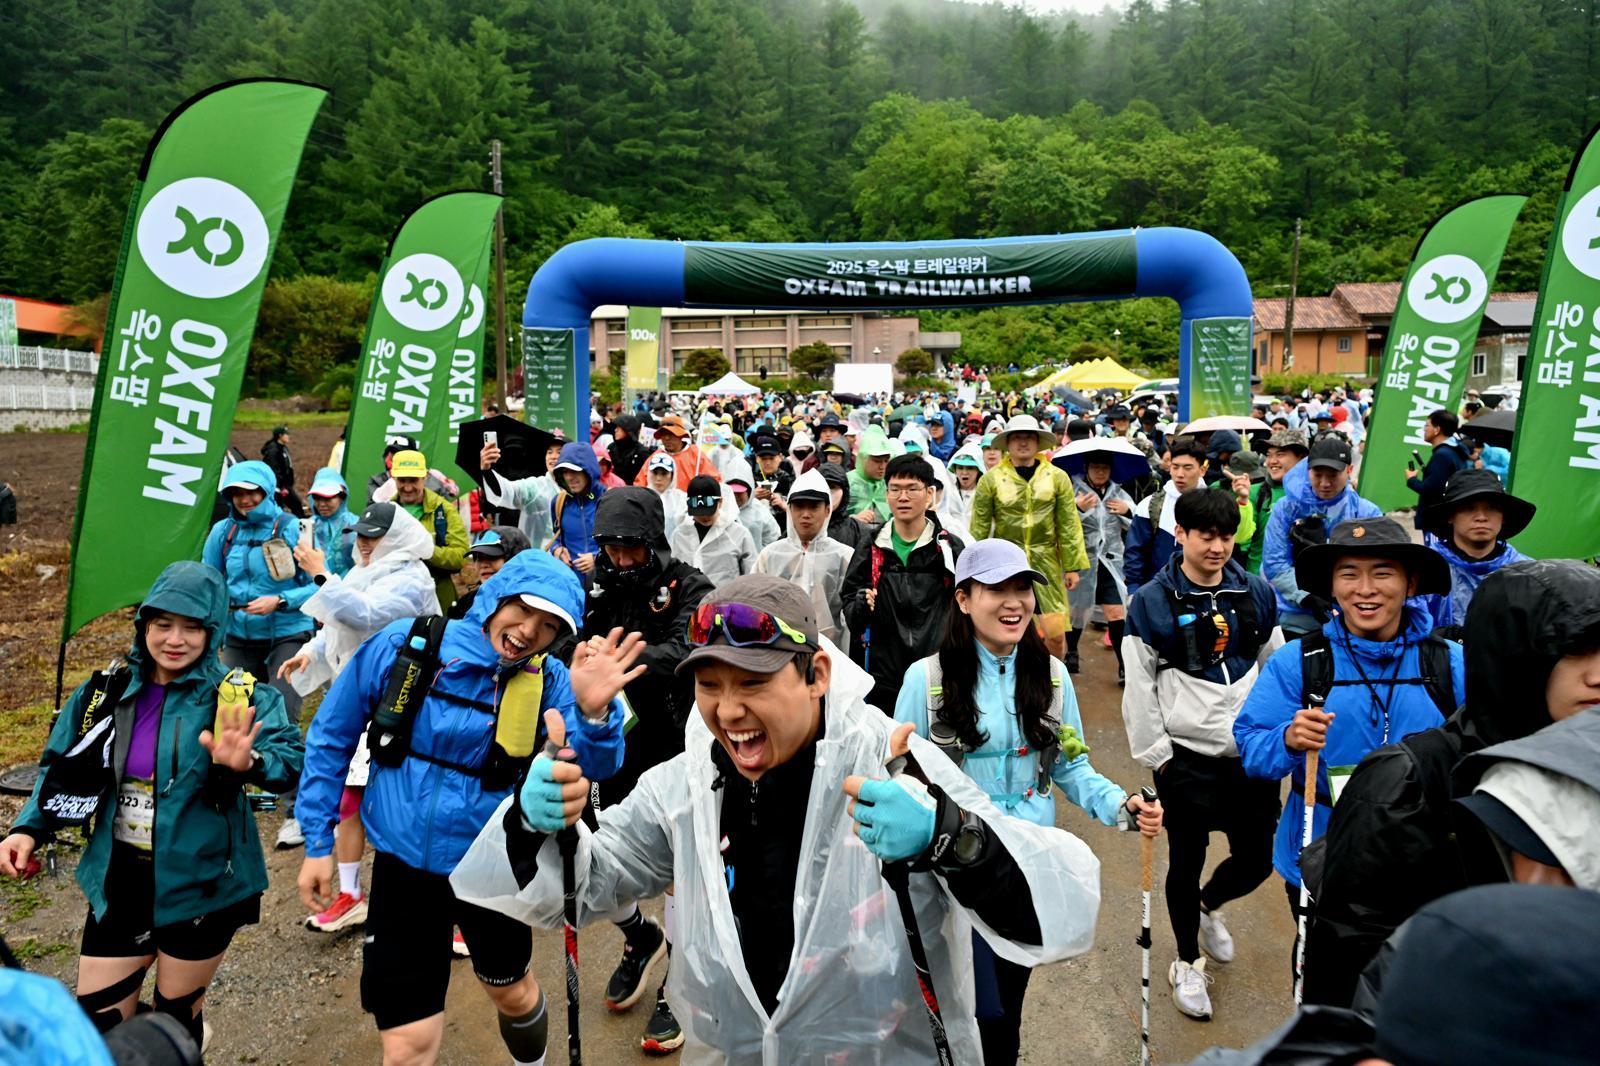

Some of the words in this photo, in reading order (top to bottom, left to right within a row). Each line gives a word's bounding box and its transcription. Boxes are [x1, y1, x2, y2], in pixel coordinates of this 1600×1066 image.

[784, 278, 867, 296] OXFAM
[875, 275, 1032, 296] TRAILWALKER
[826, 260, 863, 274] 2025
[865, 259, 910, 275] 옥스팜
[913, 256, 987, 275] 트레일워커
[110, 308, 162, 408] 옥스팜
[631, 328, 657, 341] 100K
[1385, 332, 1419, 391] 옥스팜
[1538, 301, 1584, 388] 옥스팜
[362, 338, 396, 402] 옥스팜
[142, 318, 228, 506] OXFAM
